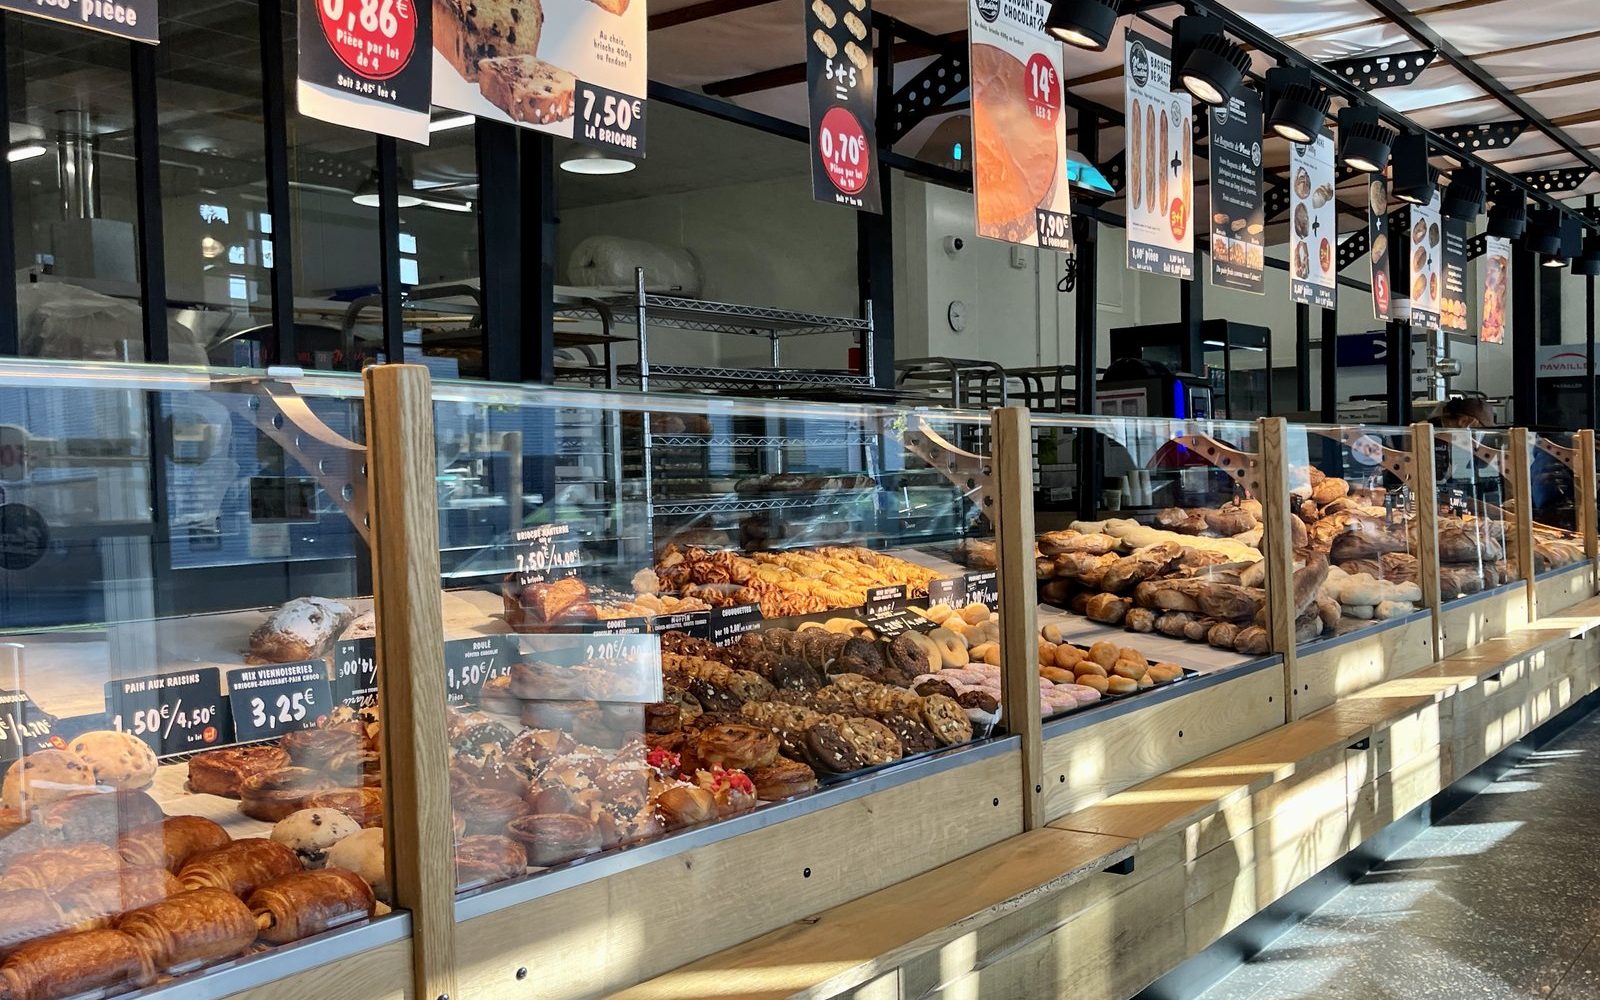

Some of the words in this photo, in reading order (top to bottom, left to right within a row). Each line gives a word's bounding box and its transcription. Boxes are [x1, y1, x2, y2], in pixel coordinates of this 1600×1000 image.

[81, 0, 137, 27] pièce
[1003, 4, 1036, 29] CHOCOLAT
[1035, 3, 1045, 17] AU
[336, 28, 364, 49] Pièce
[367, 41, 384, 55] par
[386, 43, 400, 60] lot
[599, 30, 608, 41] Au
[593, 39, 615, 54] brioche
[616, 48, 632, 62] 400g
[356, 52, 369, 68] de
[371, 57, 379, 71] 4
[596, 53, 605, 62] ou
[605, 53, 627, 68] fondant
[337, 74, 354, 89] Soit
[377, 85, 389, 98] les
[390, 89, 397, 101] 4
[1031, 62, 1055, 103] 14€
[582, 89, 642, 131] 7,50€
[1035, 105, 1046, 119] LES
[1047, 109, 1052, 121] 2
[585, 124, 596, 139] LA
[598, 128, 638, 150] BRIOCHE
[821, 127, 865, 166] 0,70€
[829, 162, 845, 177] Pièce
[845, 166, 855, 181] par
[1039, 213, 1069, 238] 7,90€
[516, 529, 542, 542] BRIOCHE
[527, 575, 545, 583] brioche
[606, 619, 627, 629] COOKIE
[472, 639, 491, 650] ROULÉ
[241, 671, 257, 681] MIX
[258, 664, 313, 680] VIENNOISERIES
[302, 673, 320, 682] CHOCO
[124, 679, 146, 694] PAIN
[147, 677, 165, 691] AUX
[166, 674, 200, 689] RAISINS
[251, 688, 314, 729] 3,25€
[188, 733, 195, 742] Le
[195, 732, 203, 741] lot
